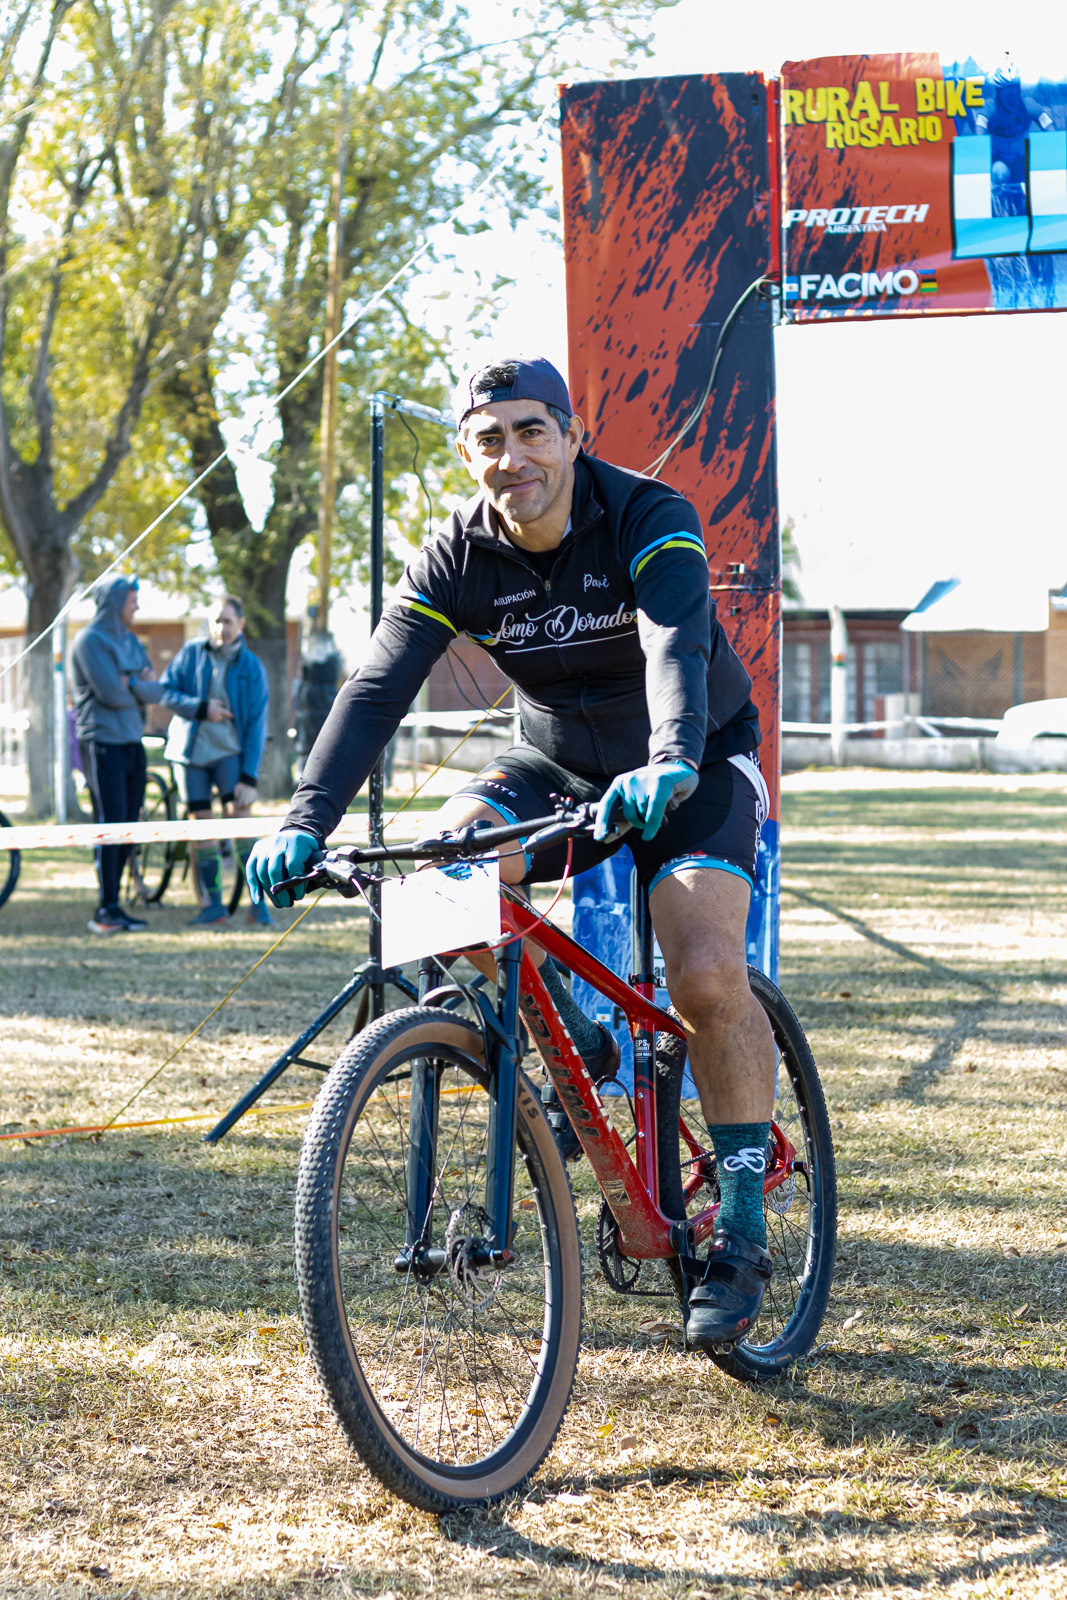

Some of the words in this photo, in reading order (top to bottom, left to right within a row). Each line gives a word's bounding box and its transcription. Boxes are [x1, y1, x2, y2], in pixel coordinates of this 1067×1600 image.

[784, 81, 900, 125] RURAL
[914, 75, 985, 117] BIKE
[825, 115, 943, 149] ROSARIO
[782, 204, 930, 229] PROTECH
[824, 223, 887, 234] ARGENTINA
[800, 269, 919, 300] FACIMO
